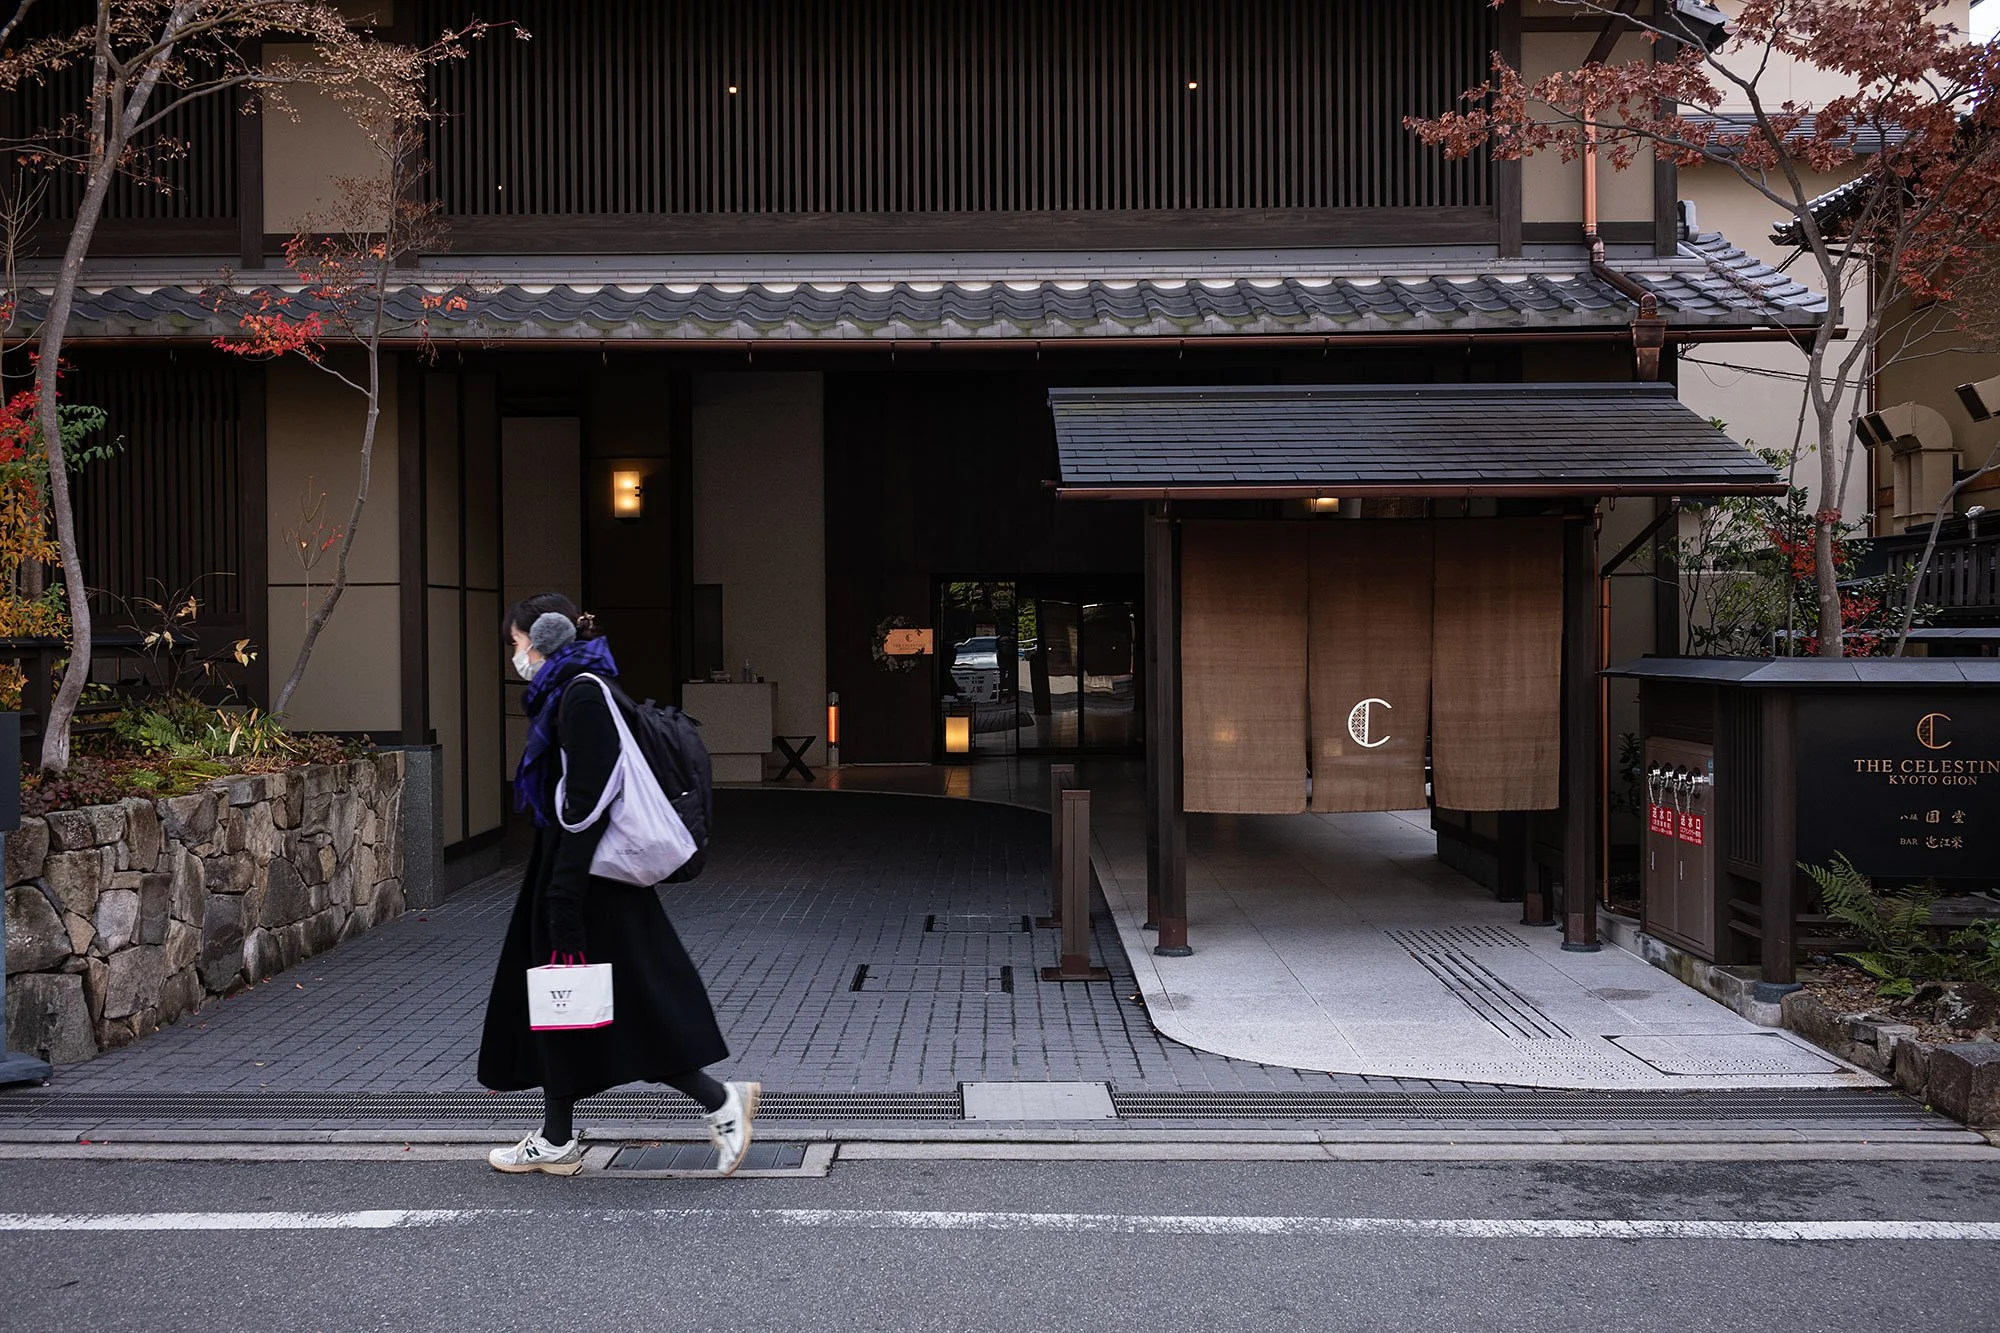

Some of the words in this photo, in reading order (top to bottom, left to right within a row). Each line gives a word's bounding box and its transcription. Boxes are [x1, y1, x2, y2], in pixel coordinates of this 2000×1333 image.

[1853, 759, 1893, 773] THE
[1888, 775, 1938, 786] KYOTO
[1942, 775, 1978, 786] GION
[1899, 837, 1919, 846] BAR
